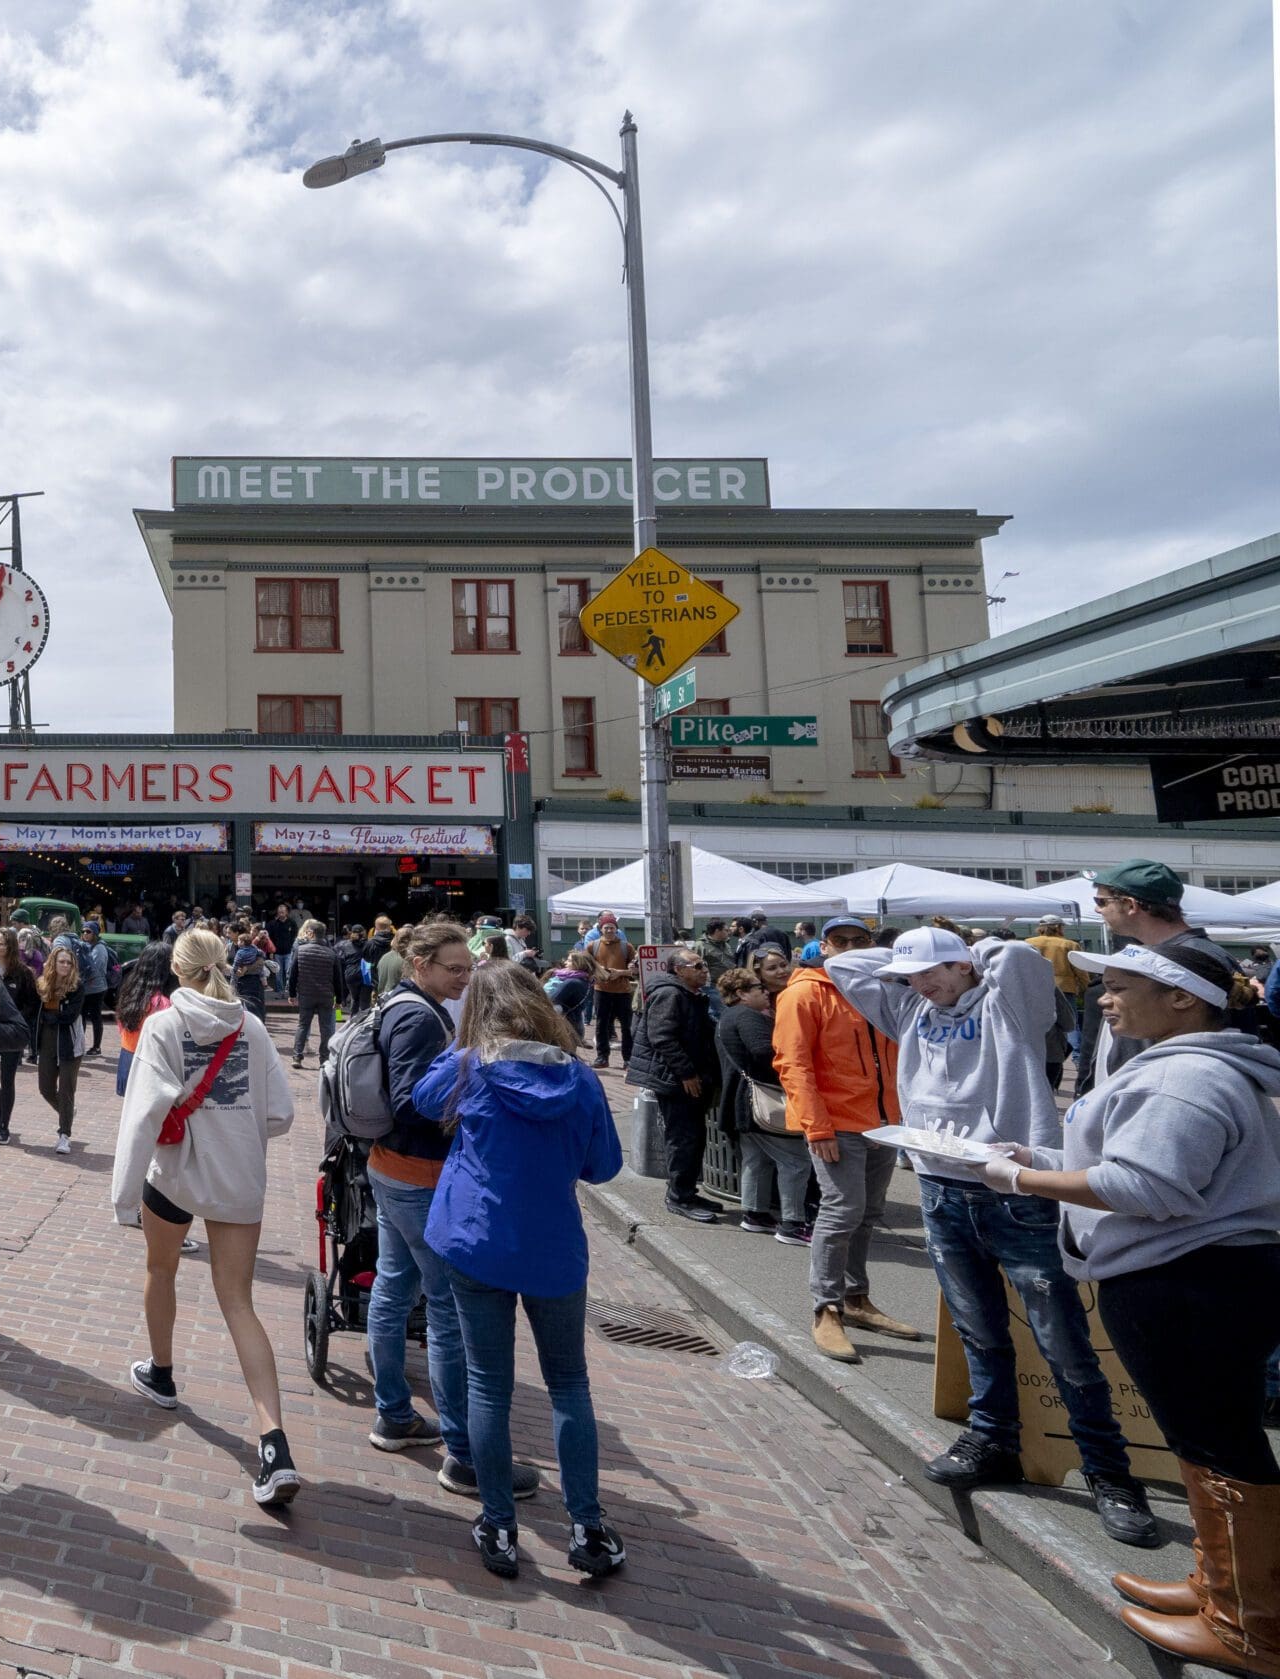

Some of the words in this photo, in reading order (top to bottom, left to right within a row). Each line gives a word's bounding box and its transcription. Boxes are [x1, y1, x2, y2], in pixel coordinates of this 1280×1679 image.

[198, 466, 322, 498] MEET
[352, 467, 441, 499] THE
[8, 573, 12, 585] 1
[627, 570, 680, 587] YIELD
[25, 590, 33, 601] 2
[642, 590, 665, 604] TO
[31, 615, 39, 627] 3
[593, 605, 717, 627] PEDESTRIANS
[23, 641, 33, 653] 4
[6, 661, 15, 672] 5
[680, 718, 735, 741] Pike
[749, 725, 768, 741] Pl
[676, 765, 698, 774] Pike
[700, 766, 728, 775] Place
[729, 766, 767, 775] Market
[4, 763, 234, 802] FARMERS
[270, 764, 486, 804] MARKET
[16, 827, 45, 841] May
[49, 829, 57, 839] 7
[71, 827, 117, 839] Mom's
[120, 827, 171, 839] Market
[175, 827, 202, 841] Day
[274, 828, 304, 841] May
[309, 830, 331, 840] 7-8
[350, 826, 405, 845] Flower
[410, 827, 468, 845] Festival
[641, 948, 655, 957] NO
[646, 961, 668, 972] STO
